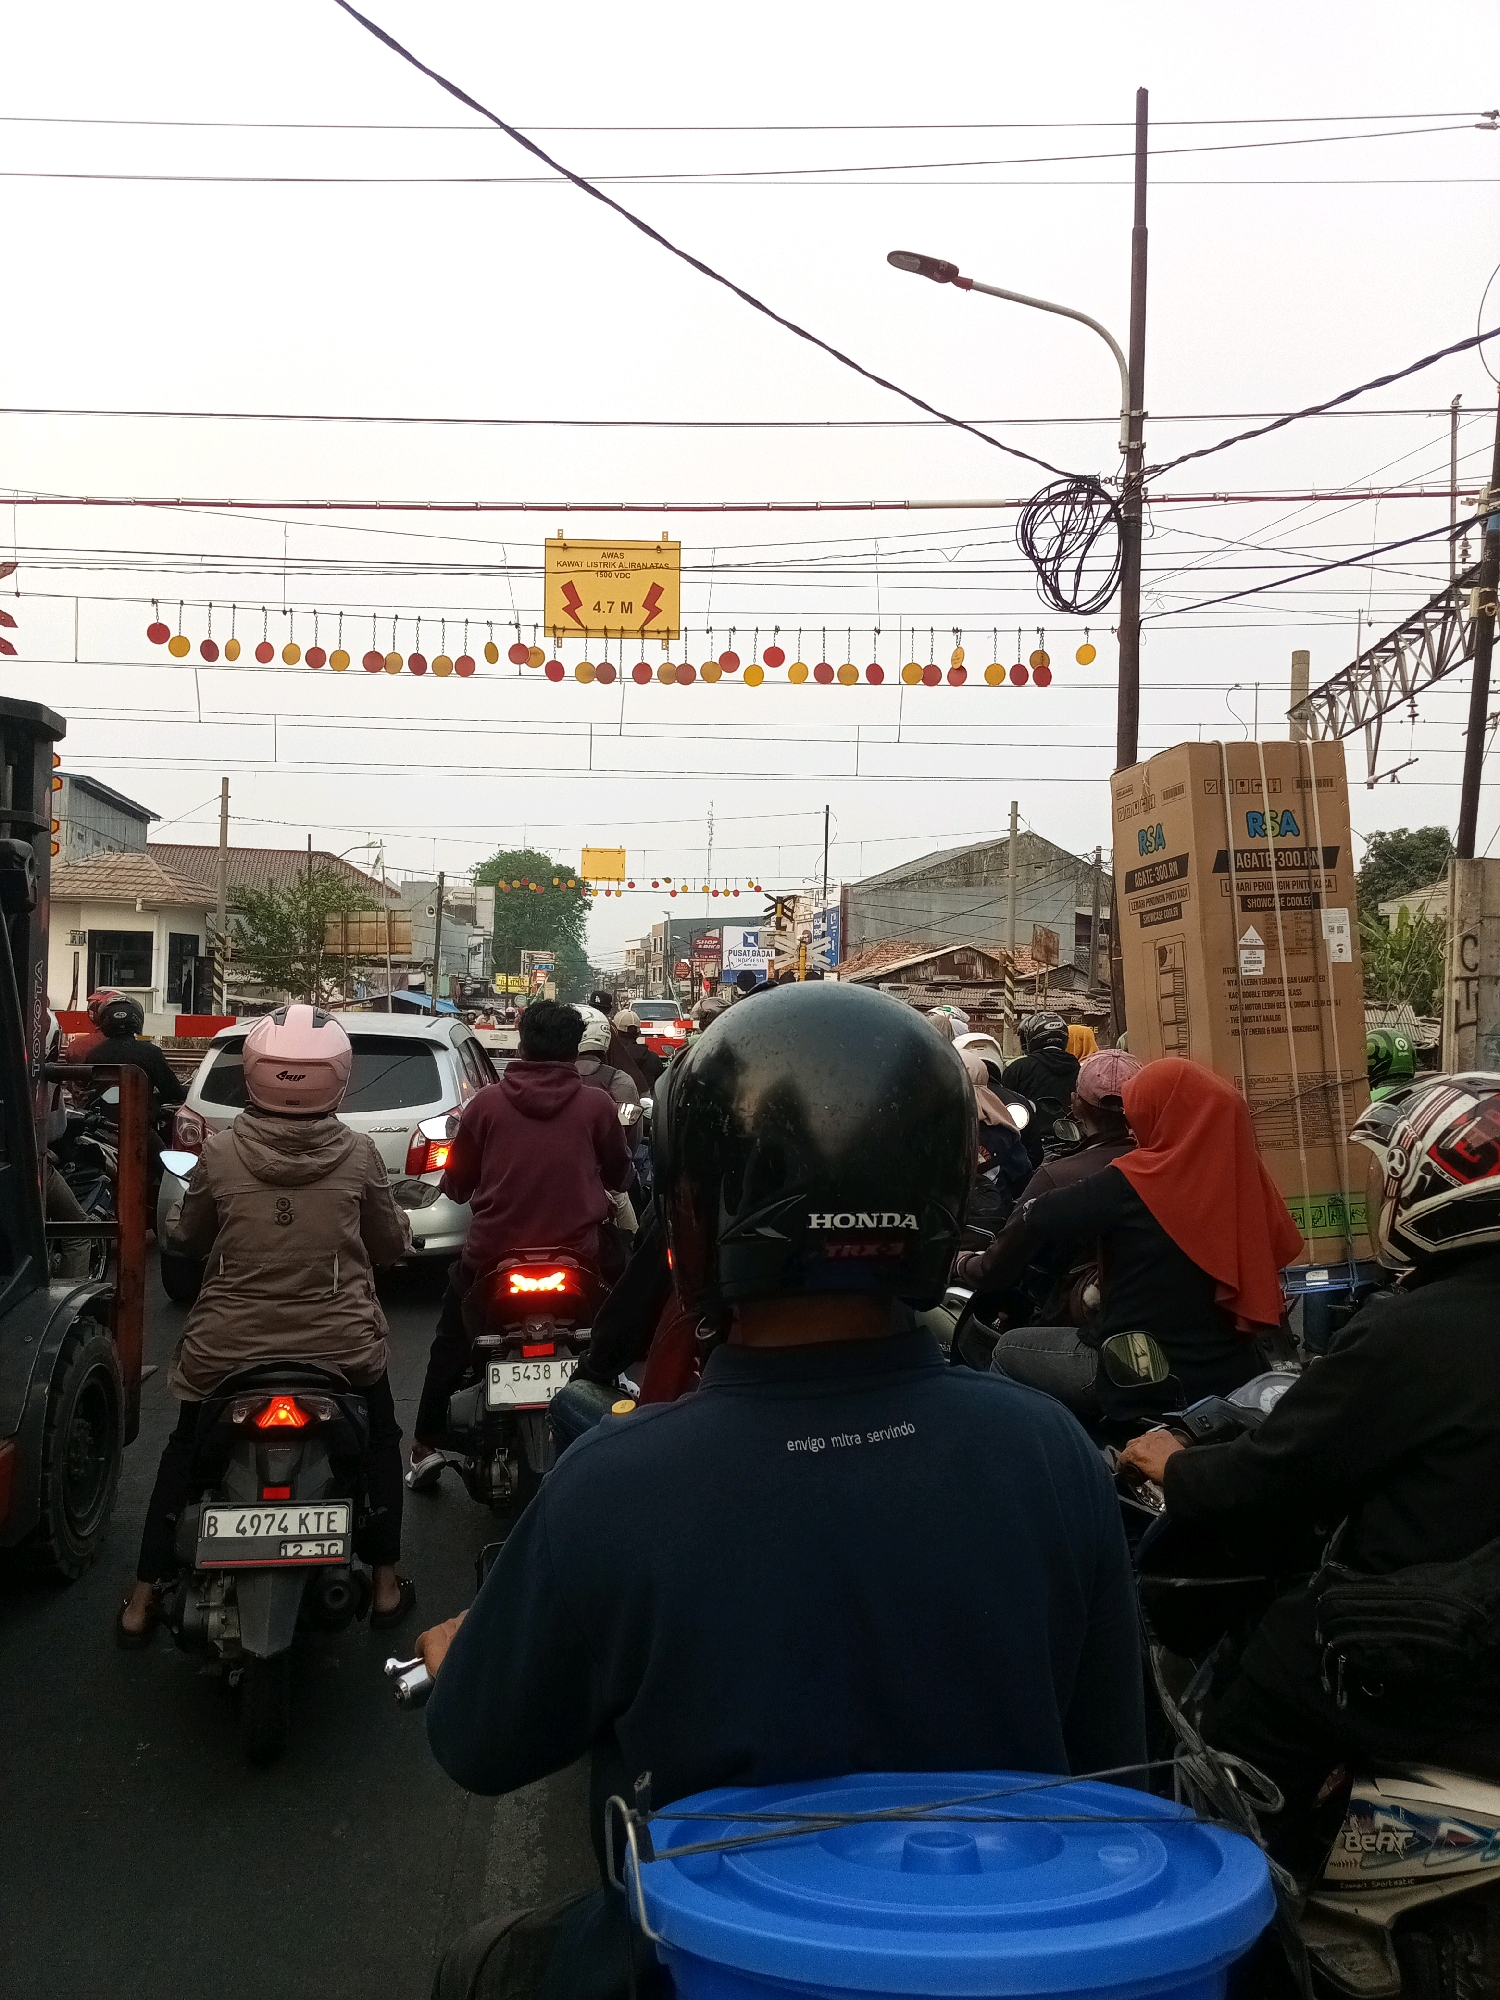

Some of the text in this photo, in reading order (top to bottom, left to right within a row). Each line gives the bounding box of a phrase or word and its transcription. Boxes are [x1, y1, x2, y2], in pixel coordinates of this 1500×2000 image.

[556, 560, 584, 568] KAWAT
[586, 561, 617, 569] LISTRIK
[618, 561, 649, 569] ALIRAN
[595, 571, 613, 579] 1500
[592, 601, 633, 614] 4.7 M
[1246, 809, 1300, 838] RSA
[1138, 822, 1166, 857] RSA
[1225, 882, 1251, 893] LMARI
[1253, 881, 1291, 892] PENDIGIN
[1247, 897, 1287, 908] SHOWCAE
[1277, 976, 1297, 984] DEGAN
[31, 959, 43, 1077] TOYOTA
[1230, 1015, 1262, 1024] THEMOSTAT
[808, 1212, 919, 1230] HONDA
[491, 1367, 501, 1384] B
[512, 1364, 551, 1382] 5438
[786, 1420, 916, 1453] envigo mitra servindo
[206, 1510, 338, 1537] B 4974 KTE
